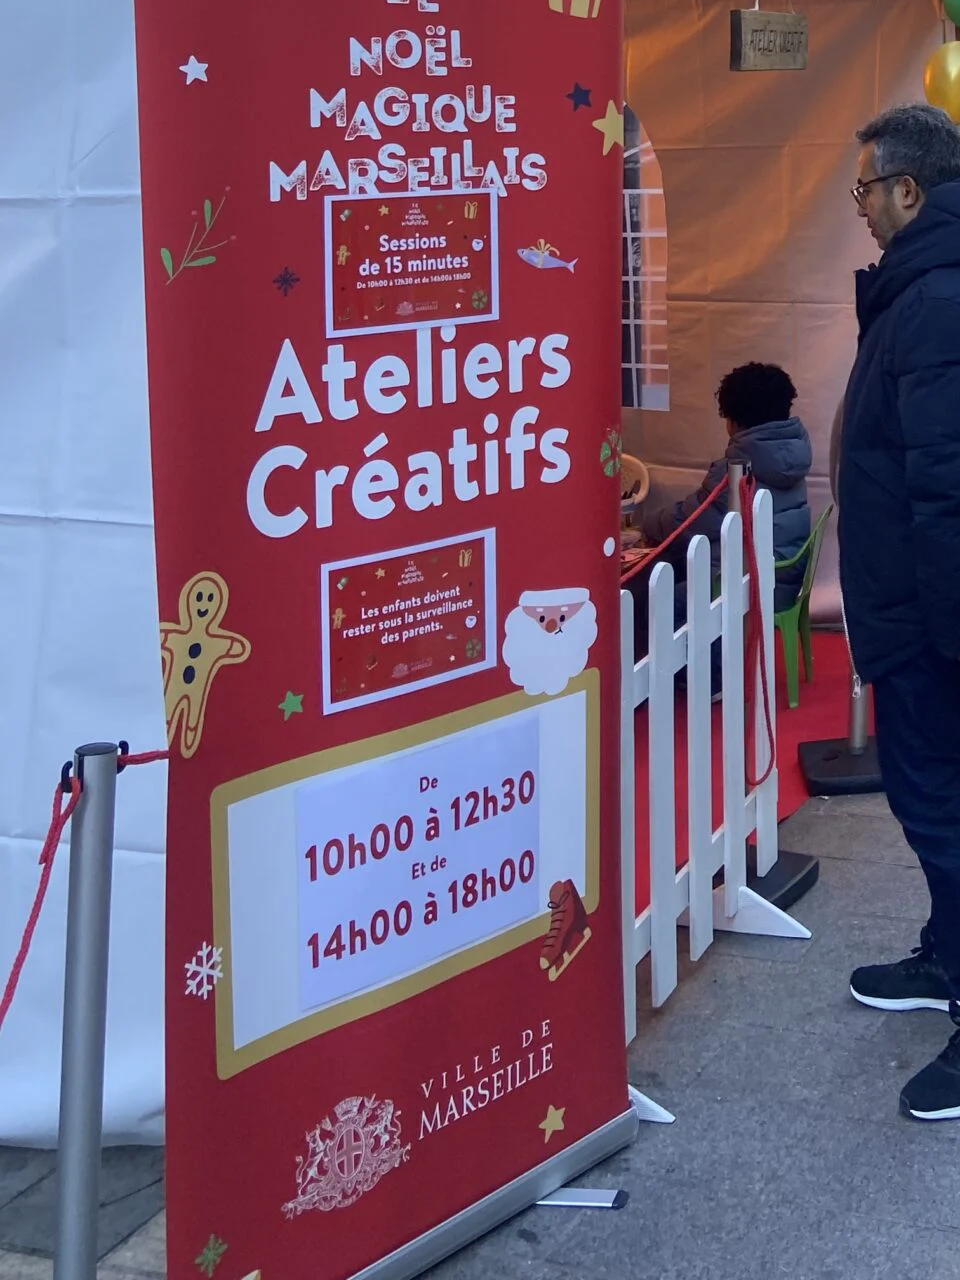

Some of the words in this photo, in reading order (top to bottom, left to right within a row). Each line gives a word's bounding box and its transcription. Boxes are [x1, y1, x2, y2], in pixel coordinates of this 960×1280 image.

[349, 24, 473, 76] NOËL
[309, 84, 517, 141] MAGIQUE
[269, 139, 548, 202] MARSEILLAIS
[359, 258, 380, 276] de
[385, 256, 403, 274] 15
[407, 254, 469, 272] minutes
[379, 233, 447, 252] Sessions
[356, 281, 366, 289] De
[254, 324, 571, 432] Ateliers
[246, 405, 571, 538] Créatifs
[343, 621, 379, 639] rester
[378, 615, 402, 631] sous
[404, 612, 413, 624] la
[416, 598, 473, 622] surveillance
[361, 607, 379, 620] Les
[382, 596, 421, 614] enfants
[424, 585, 461, 604] doivent
[381, 632, 399, 645] des
[402, 622, 444, 643] parents.
[419, 776, 438, 793] De
[305, 815, 414, 882] 10h00
[425, 807, 440, 842] à
[450, 770, 535, 831] 12h30
[412, 862, 426, 880] Et
[430, 855, 447, 873] de
[307, 900, 412, 969] 14h00
[423, 891, 438, 925] à
[448, 850, 535, 914] 18h00
[420, 1045, 501, 1099] VILLE
[521, 1019, 551, 1048] DE
[418, 1043, 554, 1141] MARSEILLE
